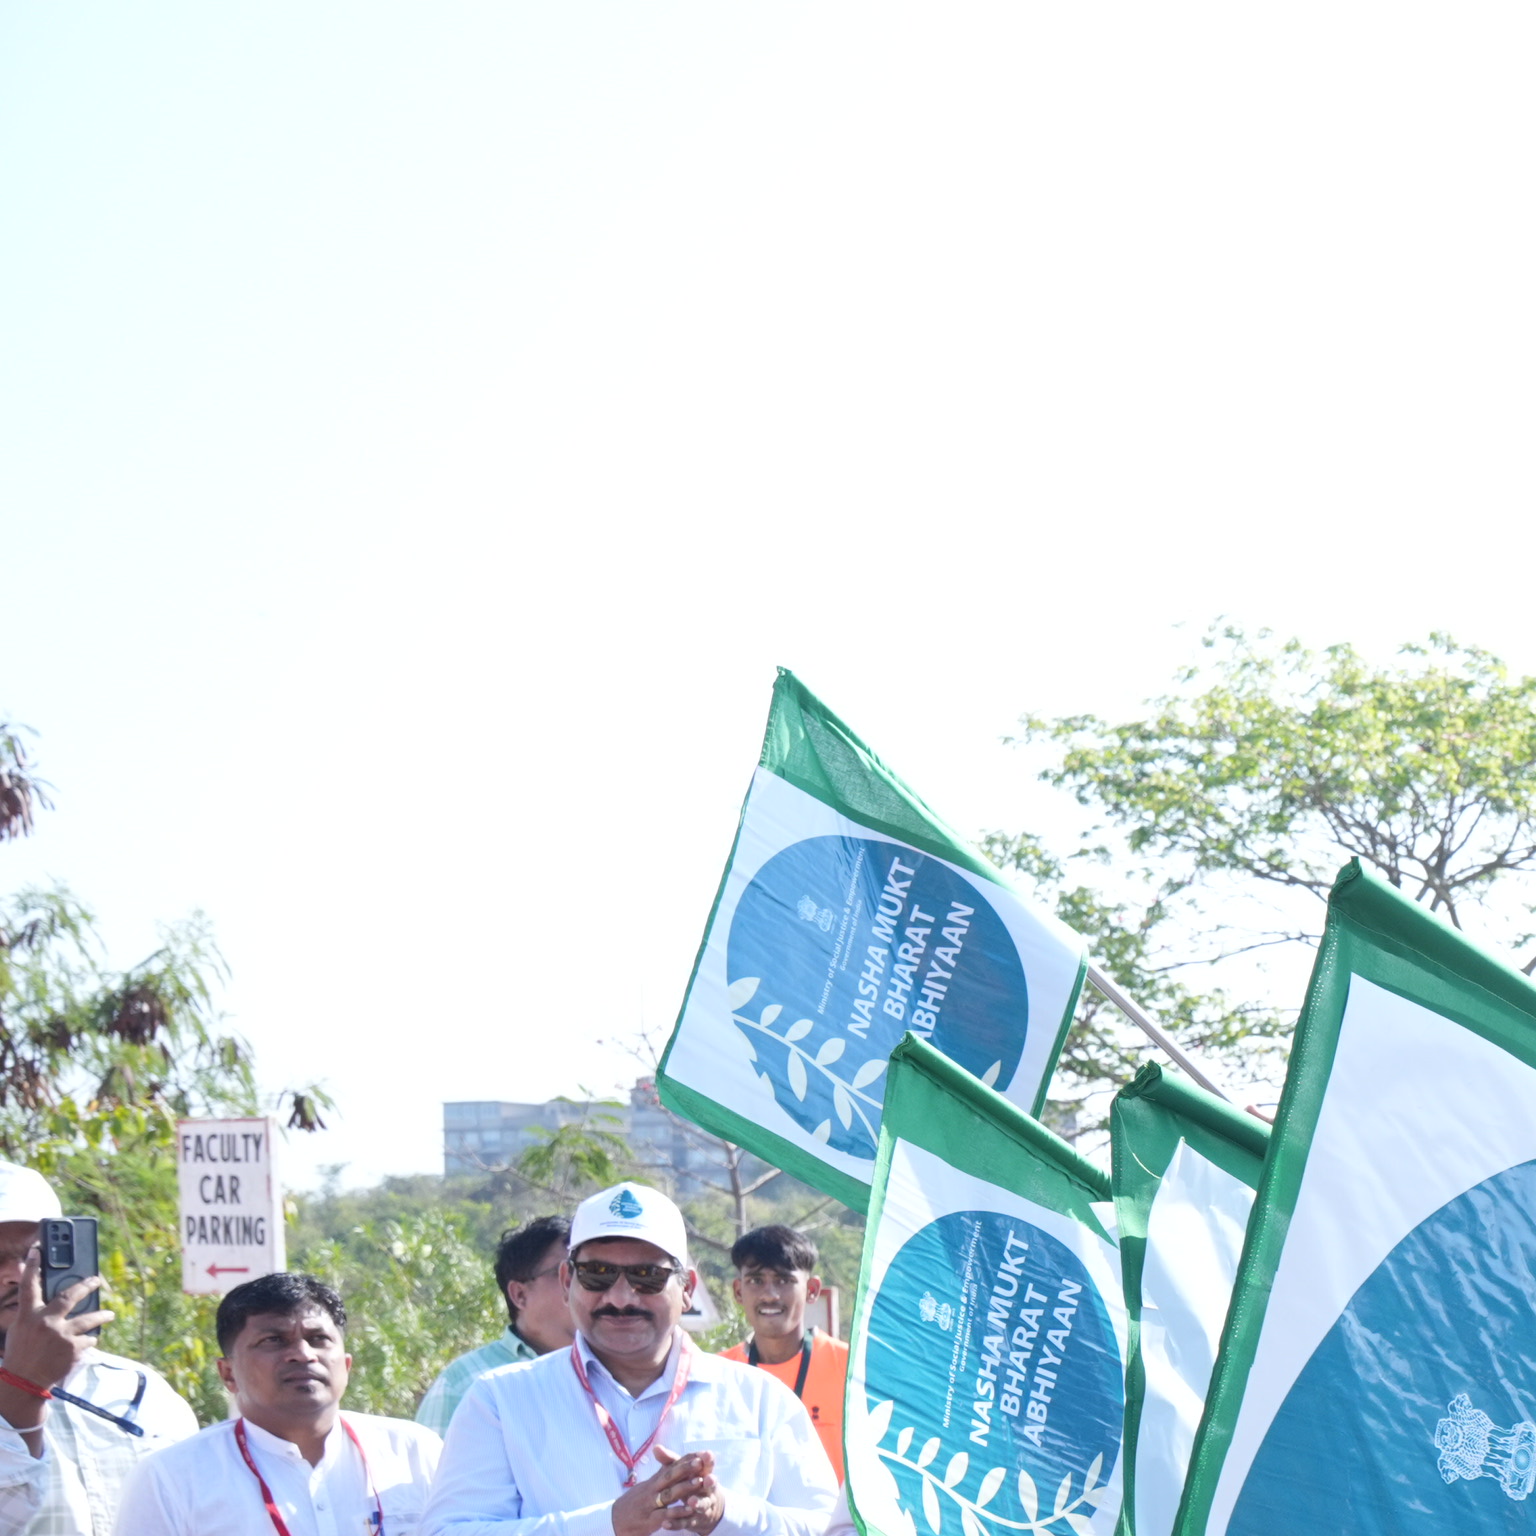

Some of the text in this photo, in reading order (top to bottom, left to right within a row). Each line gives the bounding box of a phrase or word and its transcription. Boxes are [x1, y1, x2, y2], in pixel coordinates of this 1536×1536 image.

[846, 847, 866, 906] Empowerment
[836, 915, 848, 945] Justice
[843, 907, 851, 915] &
[840, 925, 856, 971] Government
[853, 899, 862, 918] India
[847, 856, 915, 1039] NASHA MUKT
[830, 943, 841, 968] Social
[883, 904, 935, 1021] BHARAT
[817, 978, 833, 1015] Ministry
[182, 1133, 263, 1163] FACULTY
[200, 1175, 241, 1204] CAR
[186, 1216, 265, 1245] PARKING
[963, 1220, 982, 1295] Empowerment
[960, 1293, 968, 1304] &
[956, 1307, 965, 1341] Justice
[959, 1319, 974, 1372] Government
[970, 1283, 978, 1308] India
[969, 1229, 1029, 1447] NASHA MUKT
[950, 1341, 960, 1371] Social
[1000, 1282, 1048, 1417] BHARAT
[1023, 1278, 1082, 1448] ABHIYAAN
[943, 1386, 955, 1428] Ministry
